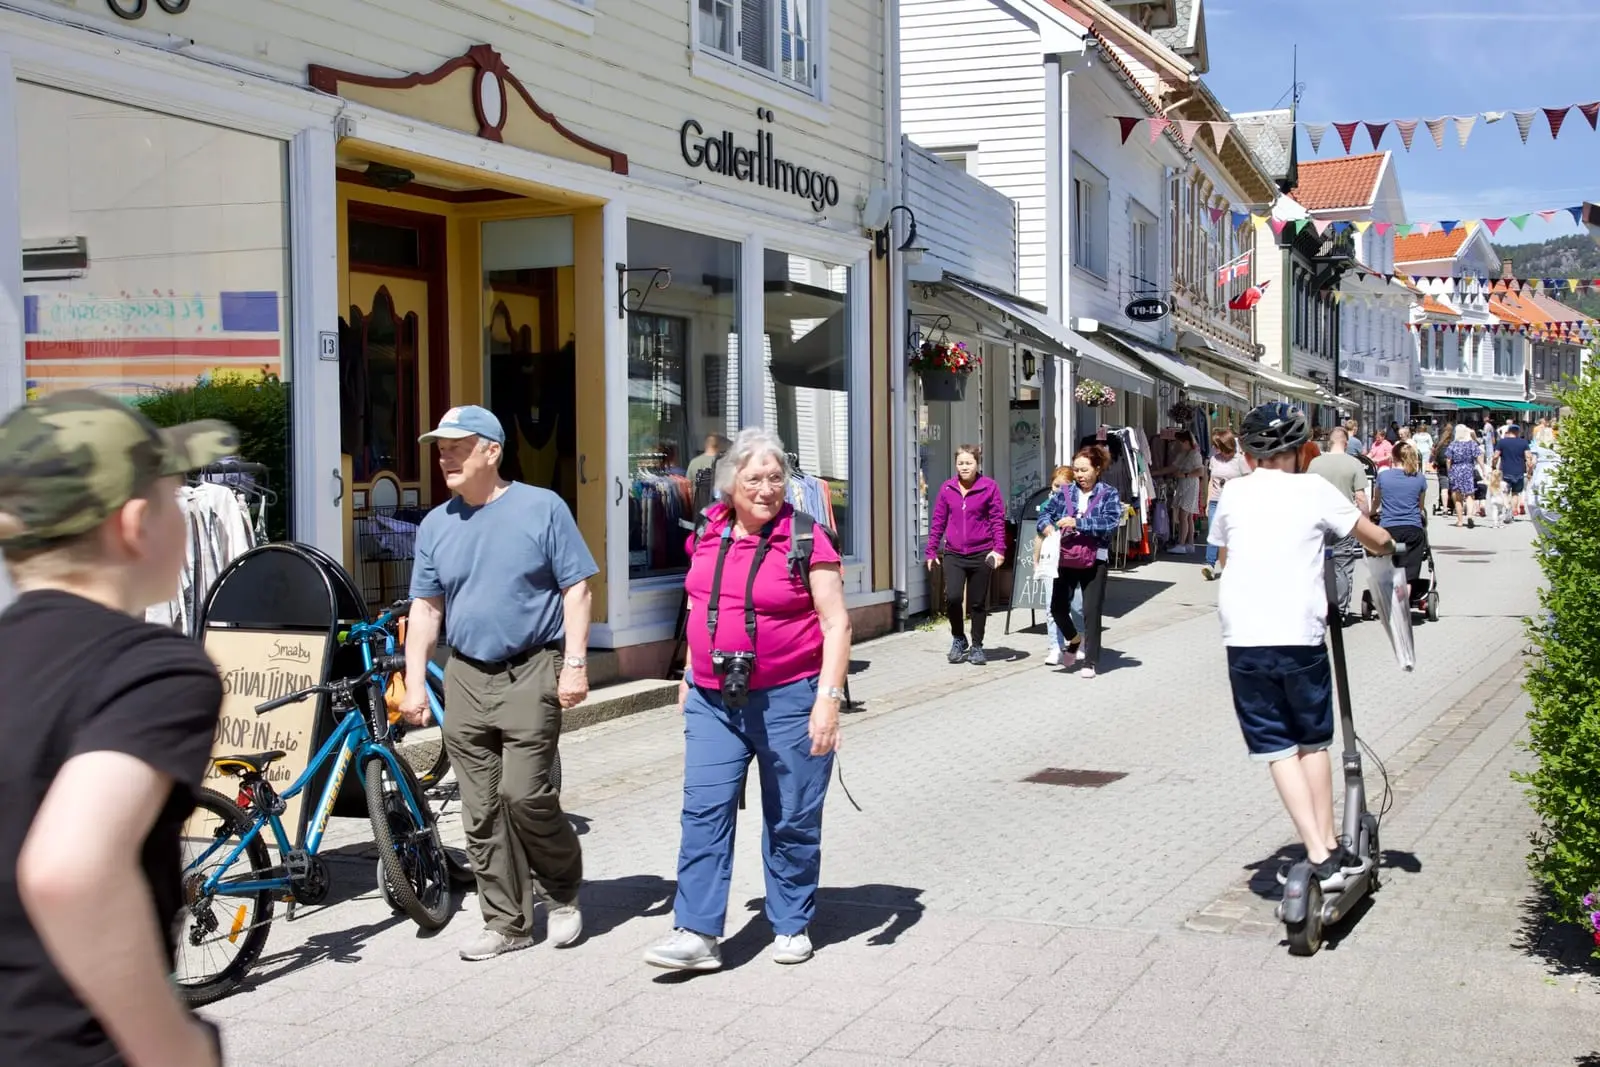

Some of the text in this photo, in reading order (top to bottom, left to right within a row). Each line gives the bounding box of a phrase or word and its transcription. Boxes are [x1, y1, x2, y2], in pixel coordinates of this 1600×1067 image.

[1132, 305, 1162, 315] TO-KA
[323, 339, 335, 354] 13
[1019, 575, 1047, 605] ÅPE
[268, 639, 311, 663] Smaaby
[317, 746, 353, 833] YOSEMITE
